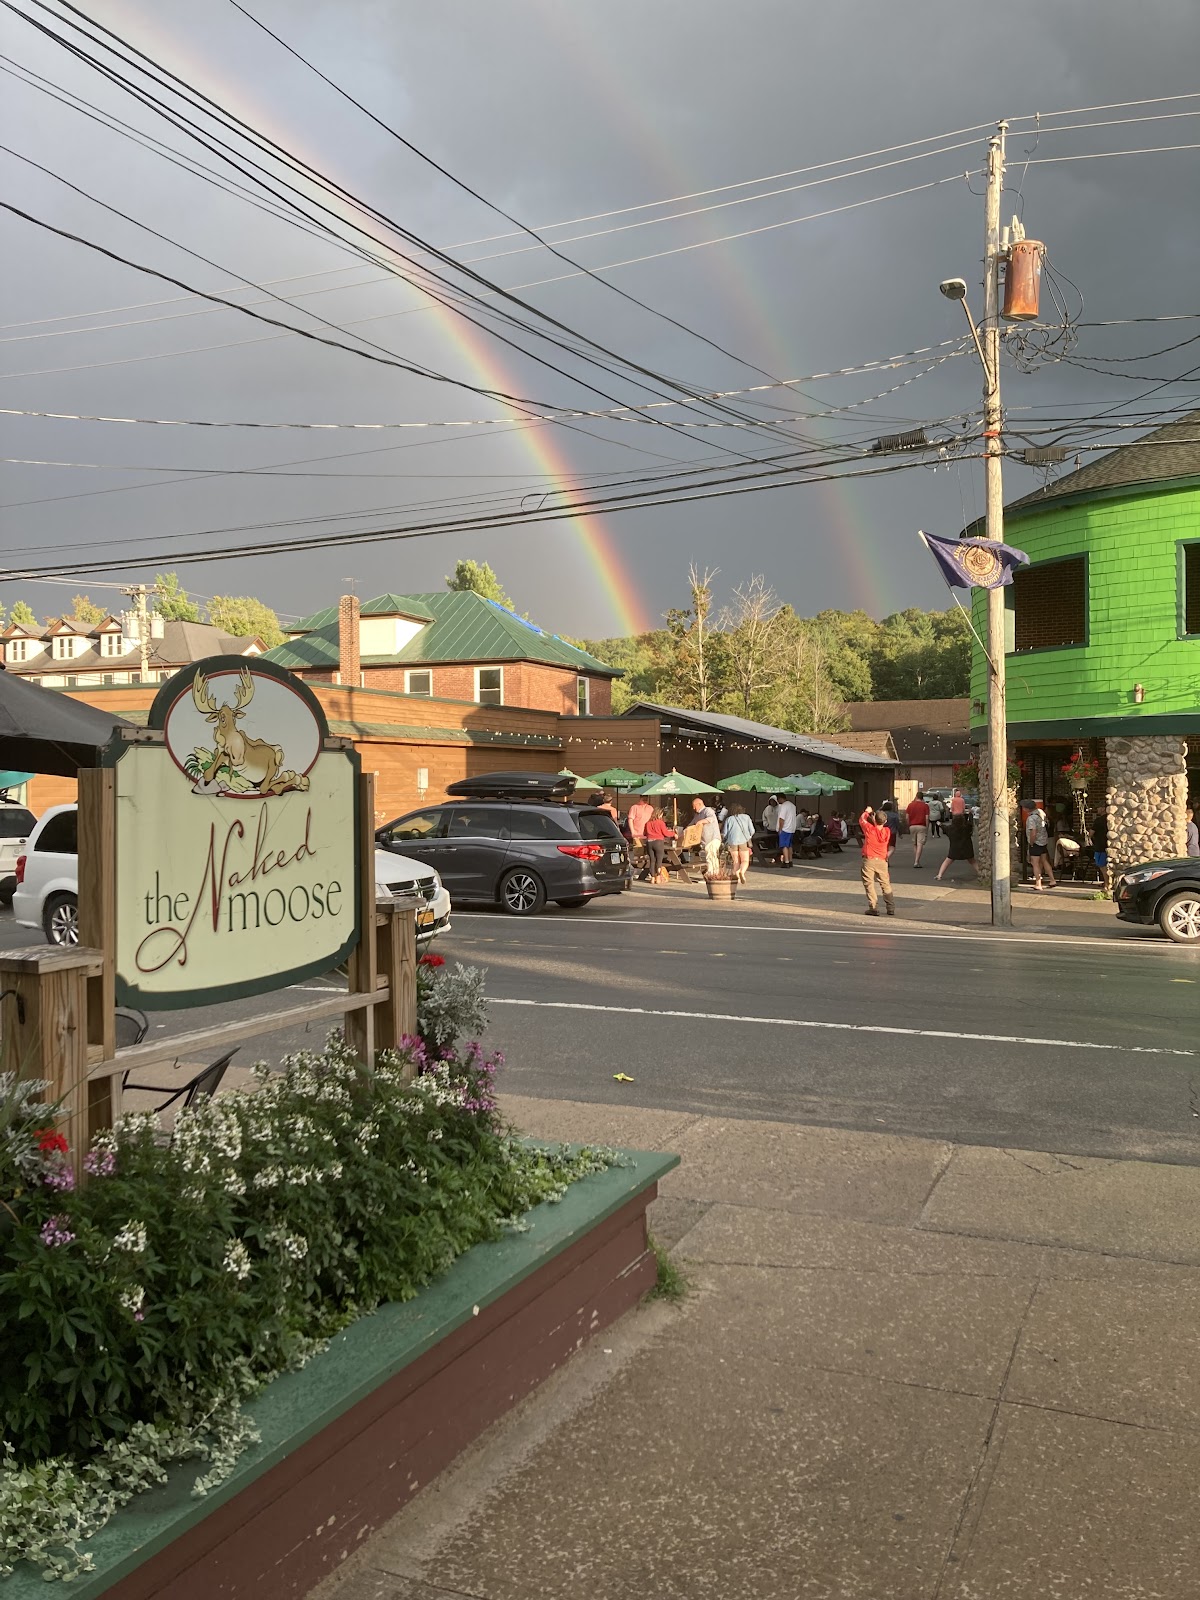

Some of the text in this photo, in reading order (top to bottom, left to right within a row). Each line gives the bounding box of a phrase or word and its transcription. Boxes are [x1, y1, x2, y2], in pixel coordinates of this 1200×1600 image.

[135, 801, 342, 973] the Naked moose
